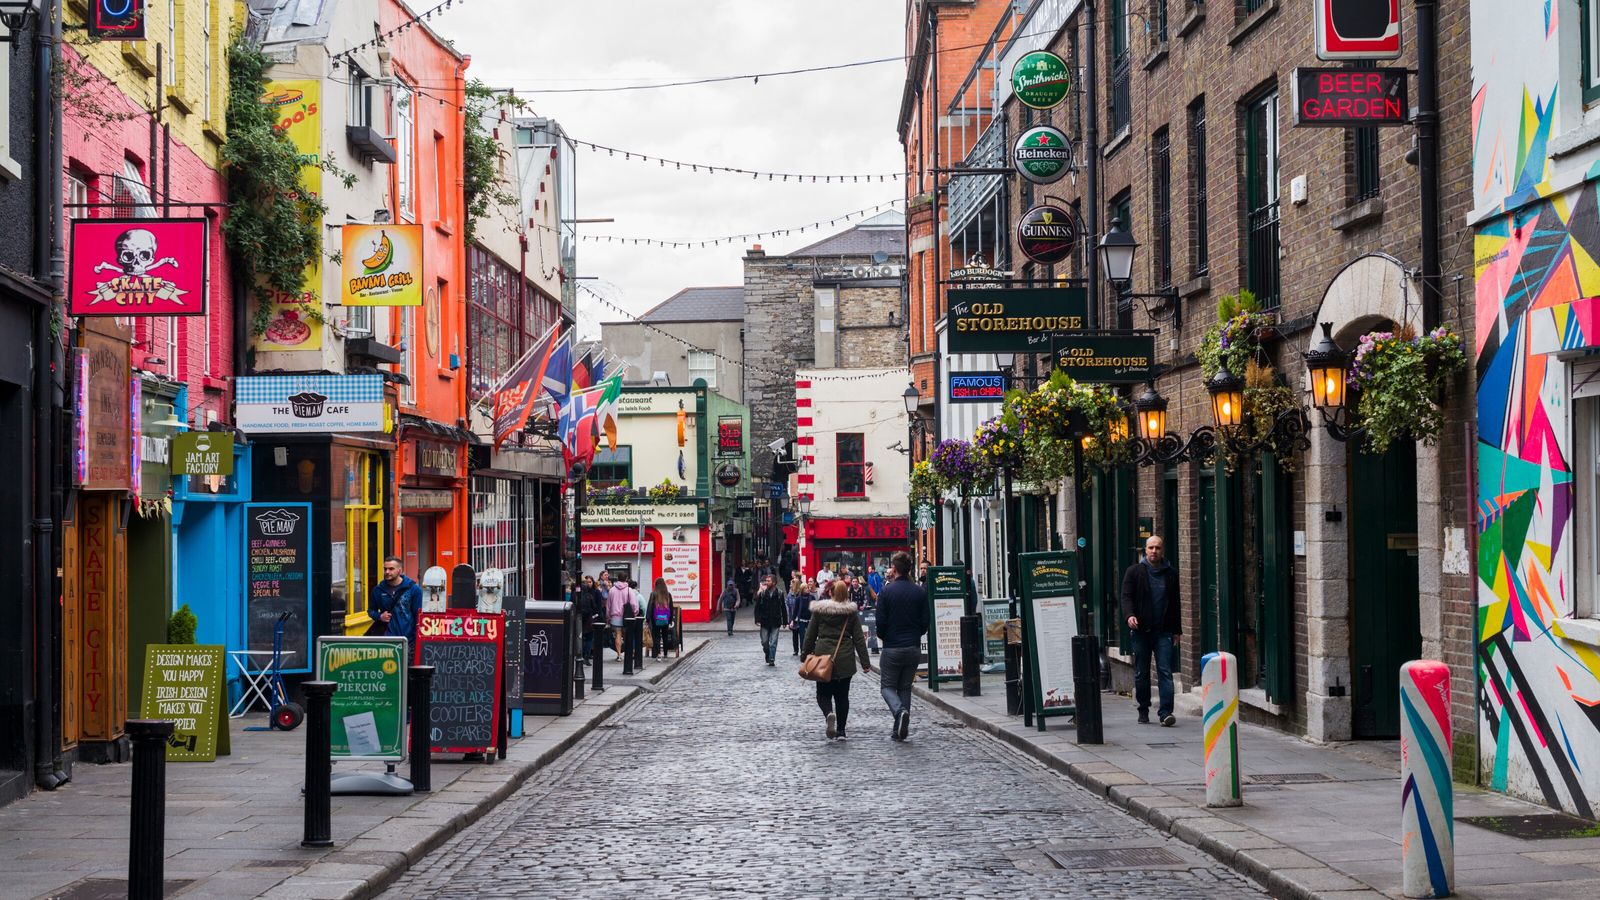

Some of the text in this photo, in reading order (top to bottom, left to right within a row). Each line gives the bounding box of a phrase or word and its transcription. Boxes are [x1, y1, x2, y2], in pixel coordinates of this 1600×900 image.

[1016, 71, 1068, 92] Smithwick's
[1320, 74, 1382, 93] BEER
[1303, 98, 1400, 118] GARDEN
[1019, 149, 1068, 159] Heineken
[1022, 224, 1072, 236] GUINNESS
[950, 270, 966, 278] LEO
[111, 277, 162, 291] SKATE
[349, 274, 386, 294] BANANA
[115, 292, 156, 305] CITY
[952, 302, 1004, 316] The OLD
[956, 316, 1081, 331] STOREHOUSE
[1028, 336, 1038, 344] Bar
[1058, 347, 1094, 357] The OLD
[1060, 357, 1147, 366] STOREHOUSE
[953, 378, 1000, 387] FAMOUS
[954, 388, 970, 396] FISH
[980, 387, 1002, 395] CHIPS
[295, 404, 322, 416] PIEMAN
[327, 406, 349, 414] CAFE
[721, 438, 740, 447] MILL
[186, 452, 220, 463] JAM ART
[186, 463, 218, 473] FACTORY
[262, 521, 293, 532] PIE MAN
[86, 506, 102, 712] SKATE CITY
[420, 617, 497, 640] SKATE CITY
[424, 645, 496, 660] SKATEBOARDS
[157, 654, 212, 666] DESIGN MAKES
[329, 648, 395, 672] CONNECTED INK
[162, 670, 204, 681] YOU HAPPY
[340, 670, 384, 682] TATTOO
[337, 681, 386, 694] PIERCING
[430, 675, 487, 691] RUISERS
[156, 687, 208, 698] IRISH DESIGN
[430, 690, 494, 703] OLLERBLADES
[159, 702, 202, 714] MAKES YOU
[430, 705, 492, 723] COOTERS
[164, 718, 196, 730] PPIER
[430, 725, 492, 742] ND SPARES
